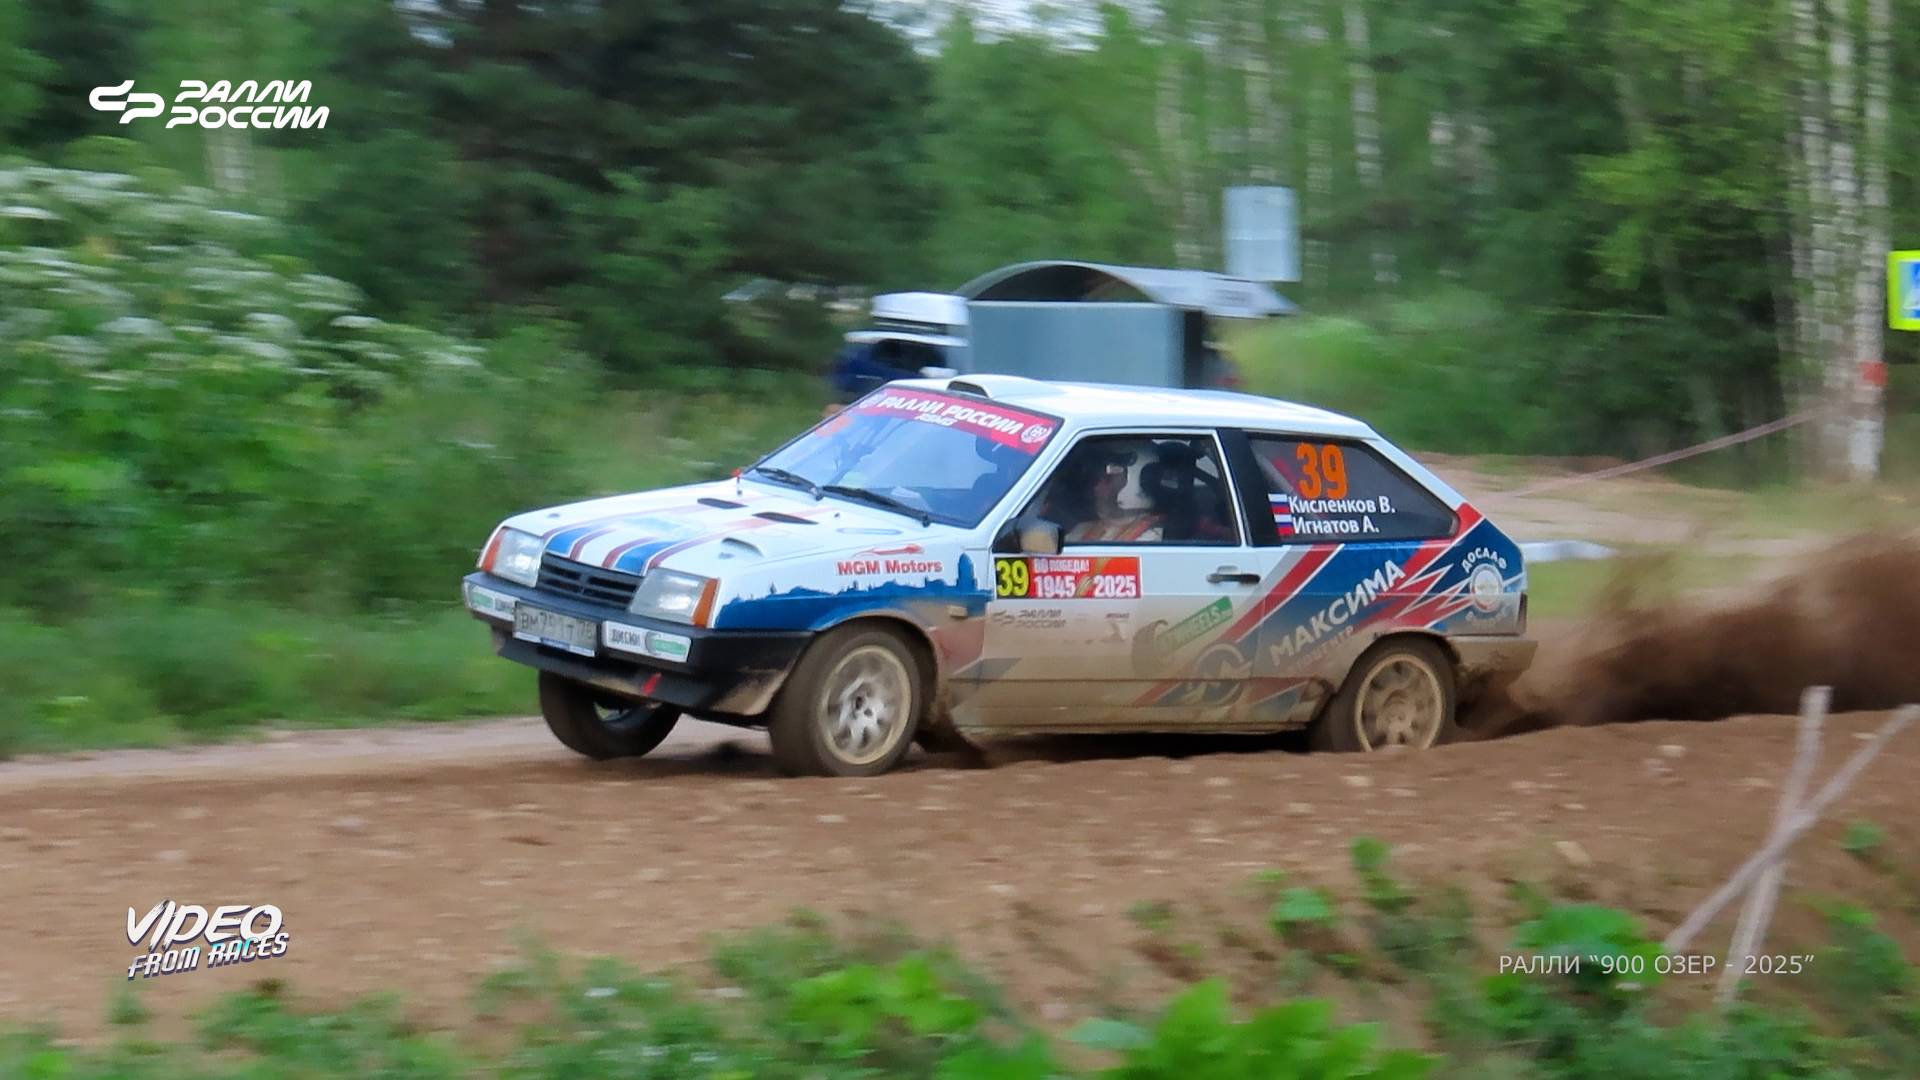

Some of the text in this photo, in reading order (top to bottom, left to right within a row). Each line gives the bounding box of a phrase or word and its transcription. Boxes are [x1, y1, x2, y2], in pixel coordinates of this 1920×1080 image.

[877, 396, 941, 415] РАЛЛИ
[942, 404, 1025, 435] РОССИИ
[1296, 442, 1348, 500] 39
[1288, 495, 1397, 514] Кисленков В.
[1292, 515, 1380, 535] Игнатов А.
[836, 558, 943, 576] MGM Motors
[996, 559, 1030, 597] 39
[1033, 574, 1137, 598] 1945 2025
[1268, 559, 1407, 667] МАКСИМА
